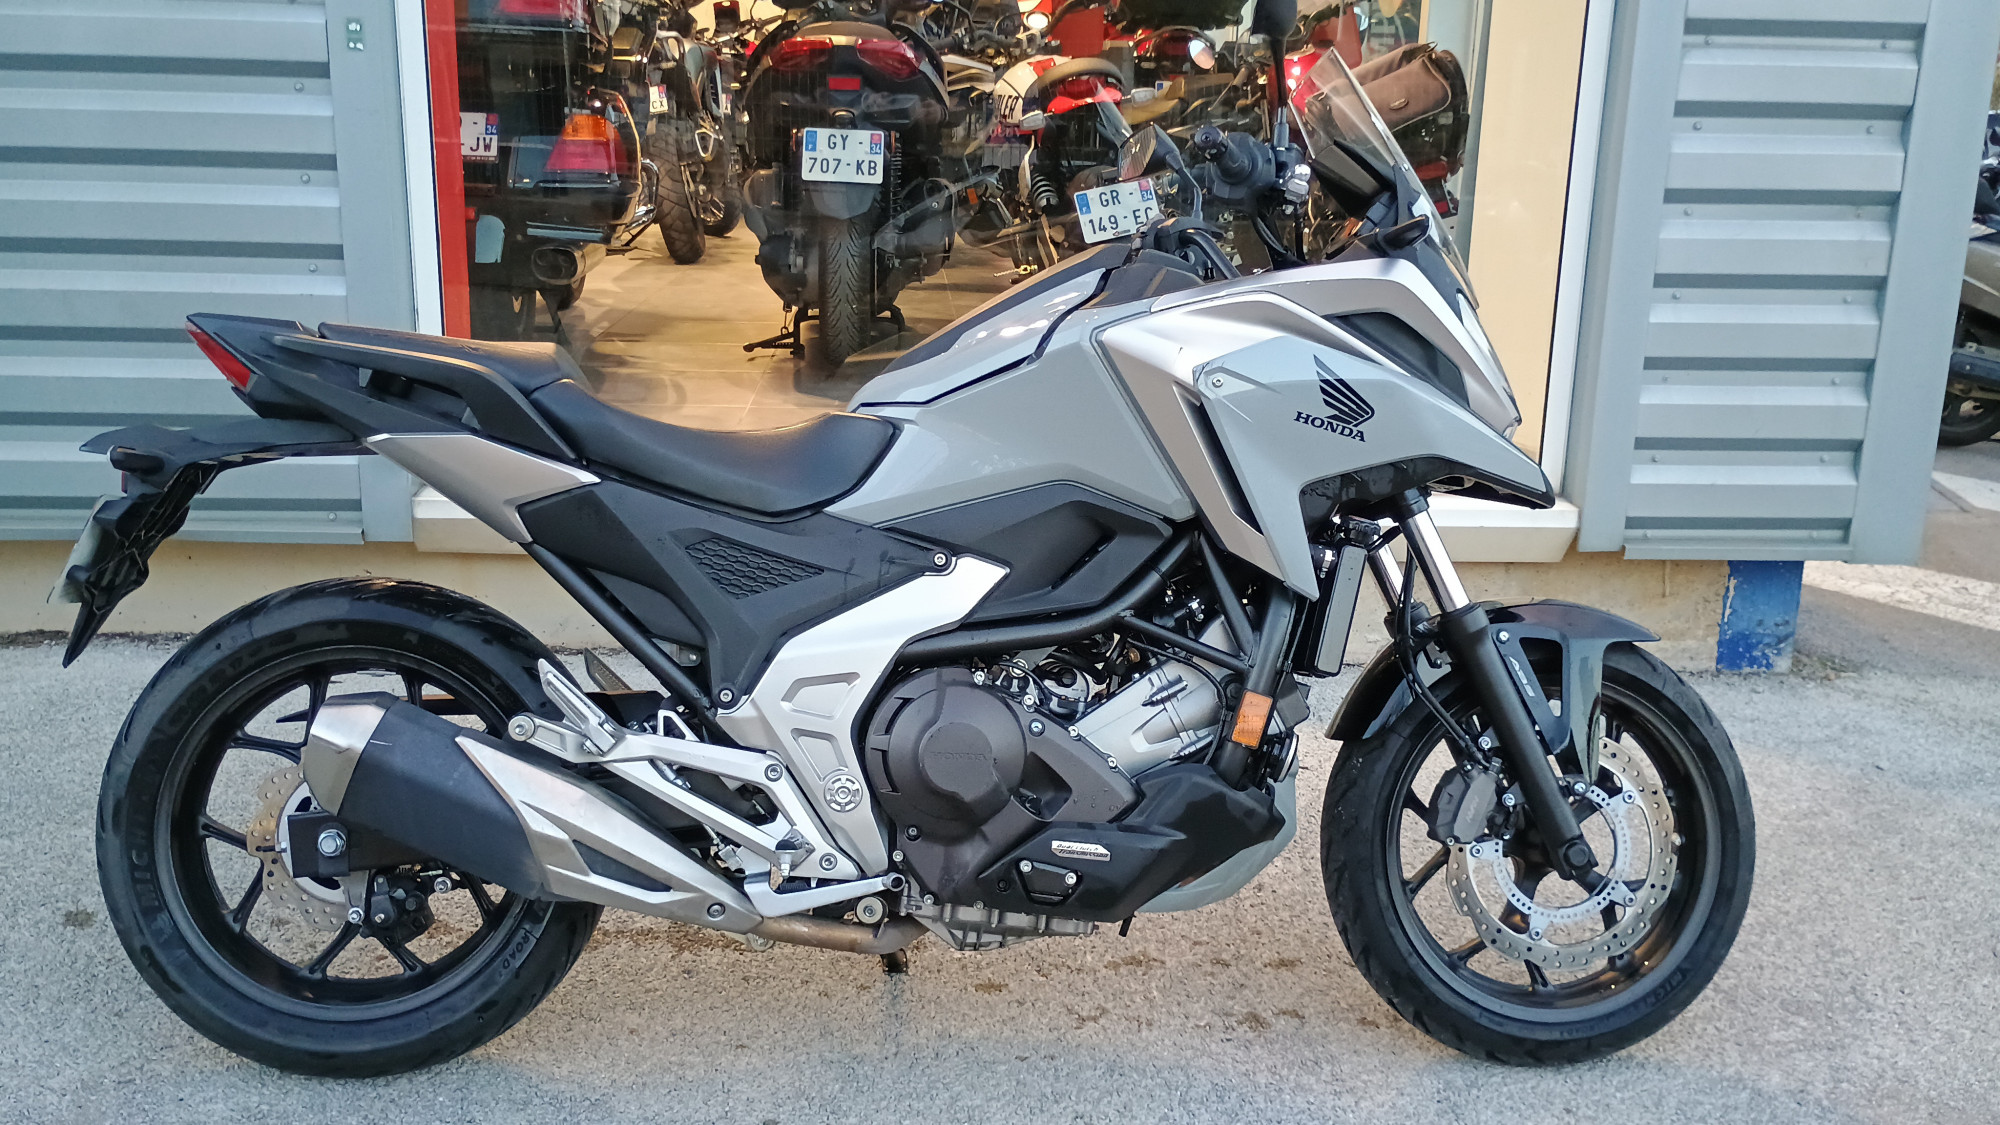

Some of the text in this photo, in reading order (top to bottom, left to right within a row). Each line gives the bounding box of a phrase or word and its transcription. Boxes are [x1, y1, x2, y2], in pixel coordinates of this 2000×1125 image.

[486, 125, 497, 134] 34
[870, 143, 881, 154] 34
[1141, 190, 1153, 201] 34
[1293, 410, 1367, 443] HONDA
